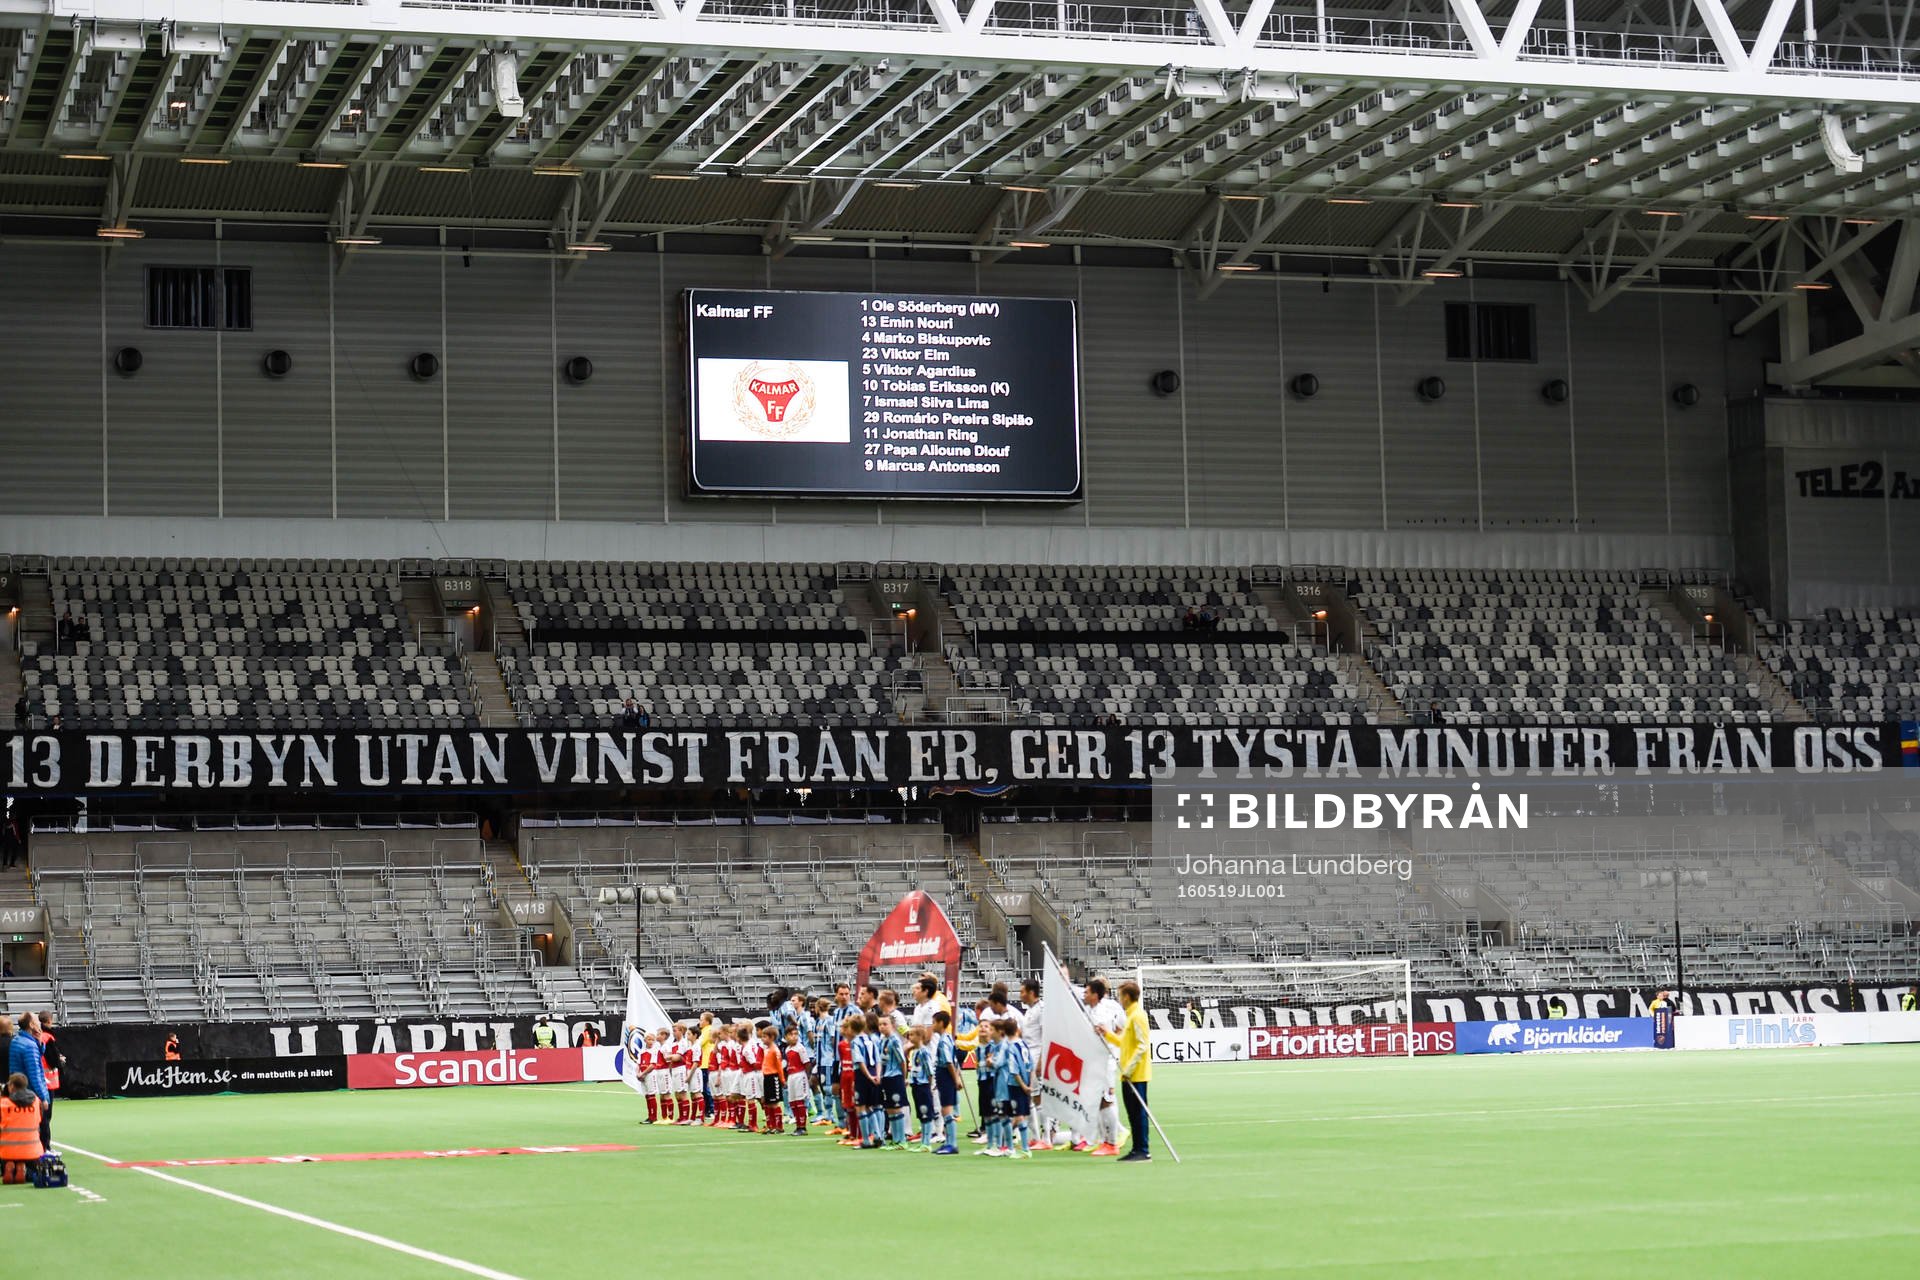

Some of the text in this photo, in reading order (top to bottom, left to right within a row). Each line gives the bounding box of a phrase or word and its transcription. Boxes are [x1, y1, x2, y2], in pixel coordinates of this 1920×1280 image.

[696, 304, 774, 319] Kalmar FF
[861, 300, 1000, 317] 1 Ole Söderberg (MV)
[861, 316, 954, 329] 13 Emin Nouri
[862, 332, 992, 348] 4 Marko Biskupovic
[862, 348, 950, 361] 23 Viktor Elm
[862, 364, 976, 379] 5 Viktor Agardius
[750, 380, 798, 395] KALMAR
[863, 380, 1010, 396] 10 Tobias Eriksson (K)
[863, 396, 990, 409] 7 Ismael Silva Lima
[863, 412, 880, 423] 29
[883, 412, 940, 424] Romário
[943, 413, 990, 425] Pereira
[864, 428, 979, 443] 11 Jonathan Ring
[864, 444, 1011, 458] 27 Papa Alioune Diouf
[864, 460, 1000, 473] 9 Marcus Antonsson
[1795, 461, 1884, 499] TELE2
[444, 580, 472, 591] B318
[883, 583, 909, 593] B317
[5, 722, 1883, 788] 13 DERBYN UTAN VINST FRÅN ER, GER 13 TYSTA MINUTER FRÅN OSS
[513, 903, 546, 914] A118
[2, 910, 35, 923] A119
[1792, 1015, 1814, 1023] JÄRN
[1523, 1025, 1623, 1049] Björnkläder
[1728, 1017, 1817, 1045] Flinks
[1251, 1025, 1454, 1056] Prioritet Finans
[1150, 1041, 1216, 1061] ICENT
[241, 1071, 255, 1079] din
[257, 1070, 296, 1079] matbutik
[298, 1069, 309, 1080] på
[310, 1069, 333, 1078] nätet
[394, 1049, 538, 1086] Scandic
